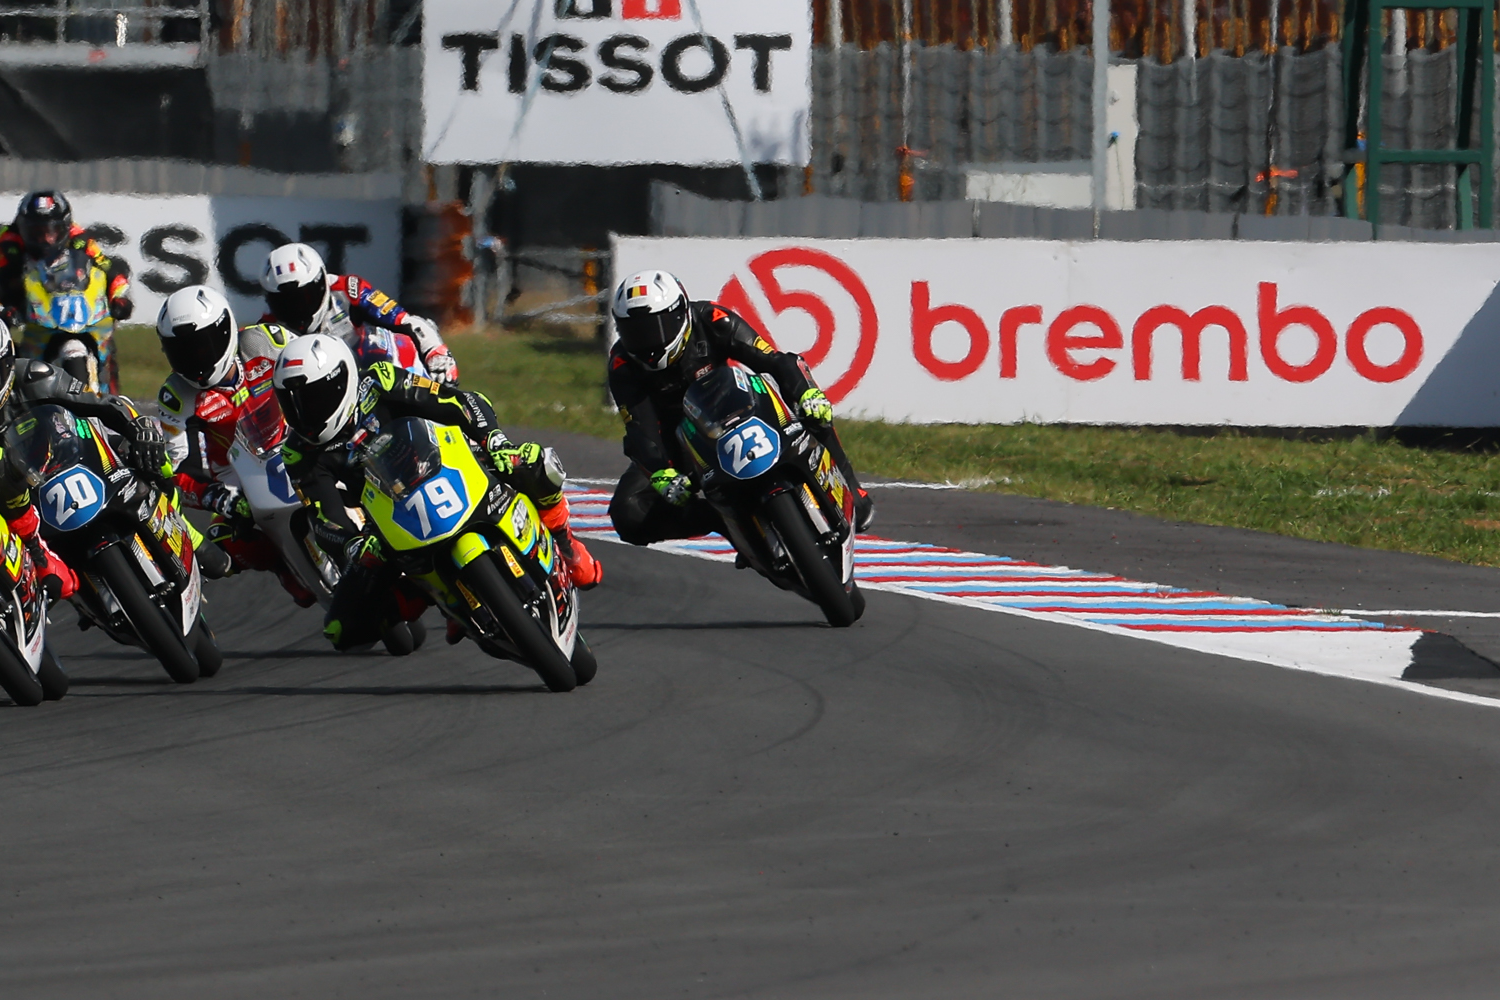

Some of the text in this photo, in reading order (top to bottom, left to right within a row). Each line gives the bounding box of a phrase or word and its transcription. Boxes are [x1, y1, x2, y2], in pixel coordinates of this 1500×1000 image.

[440, 31, 793, 94] TISSOT
[57, 299, 84, 327] 71
[911, 280, 1424, 383] brembo
[231, 386, 250, 407] 75
[724, 424, 774, 474] 23
[45, 471, 98, 526] 20
[404, 476, 464, 538] 79
